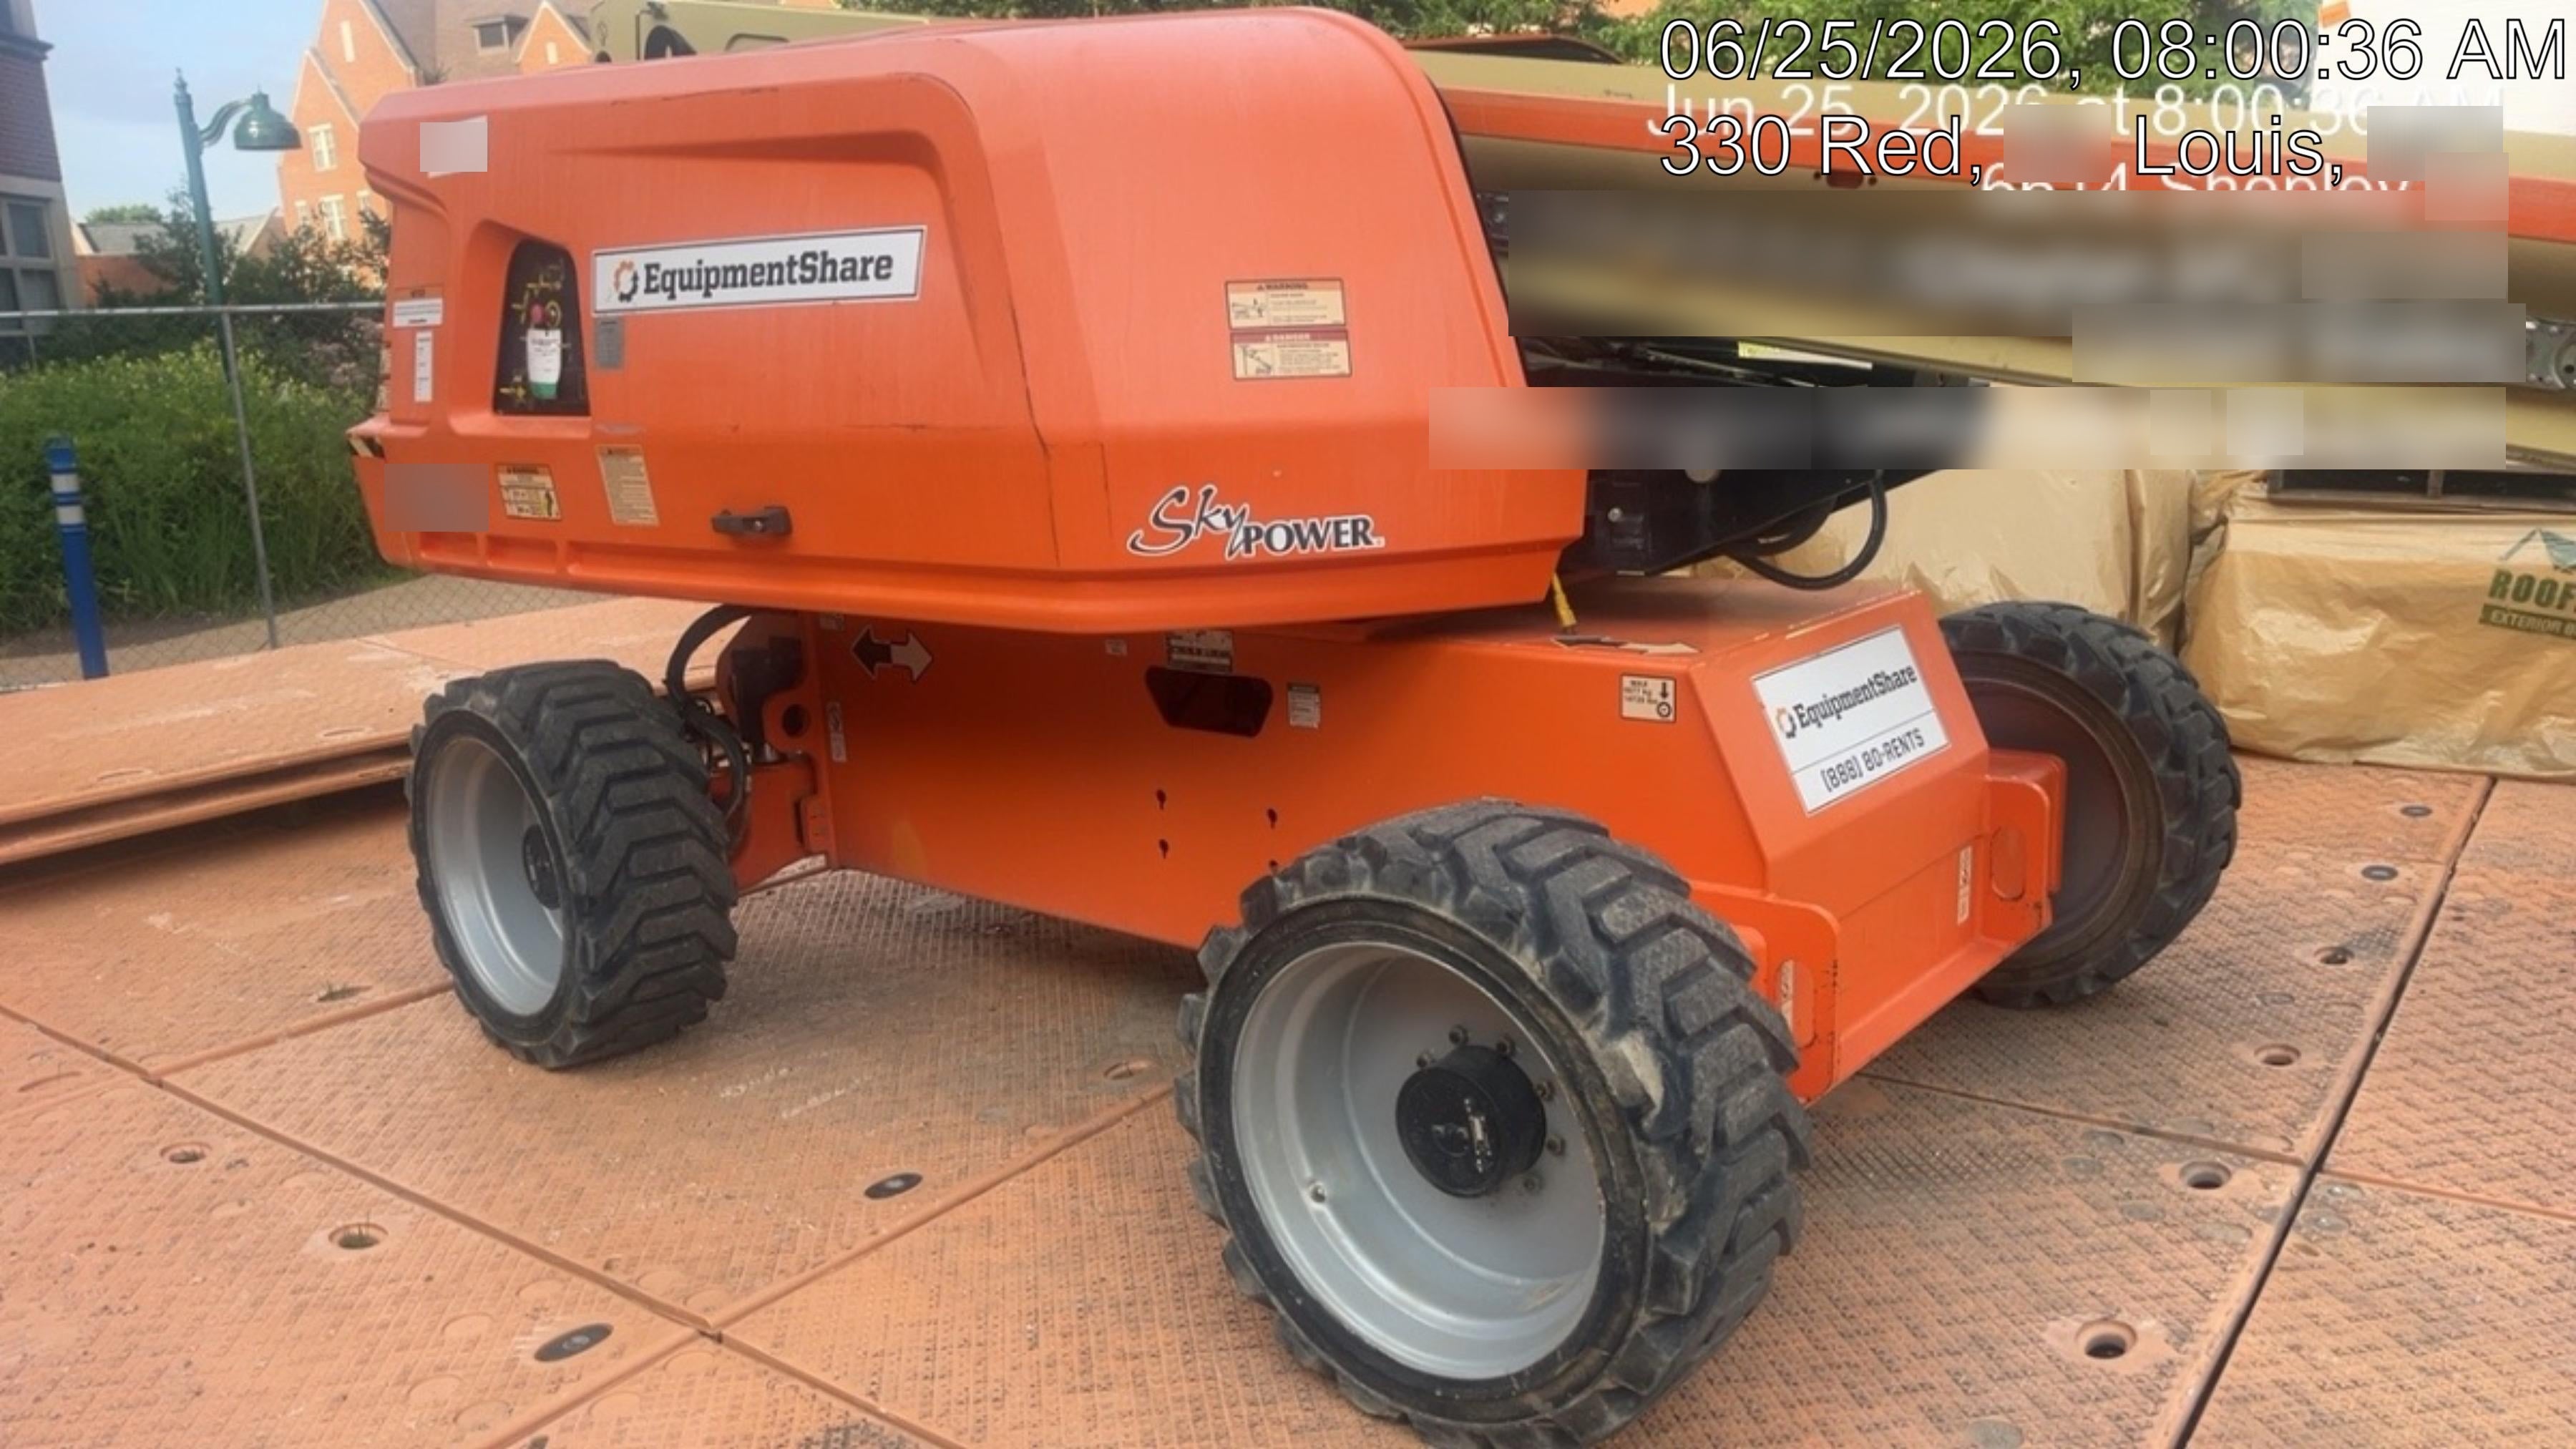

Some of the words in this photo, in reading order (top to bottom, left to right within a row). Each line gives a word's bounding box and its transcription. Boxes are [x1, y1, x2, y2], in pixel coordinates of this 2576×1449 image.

[644, 250, 893, 301] EquipmentShare
[2488, 569, 2576, 611] ROOF
[1792, 664, 1918, 728] EquipmentShare
